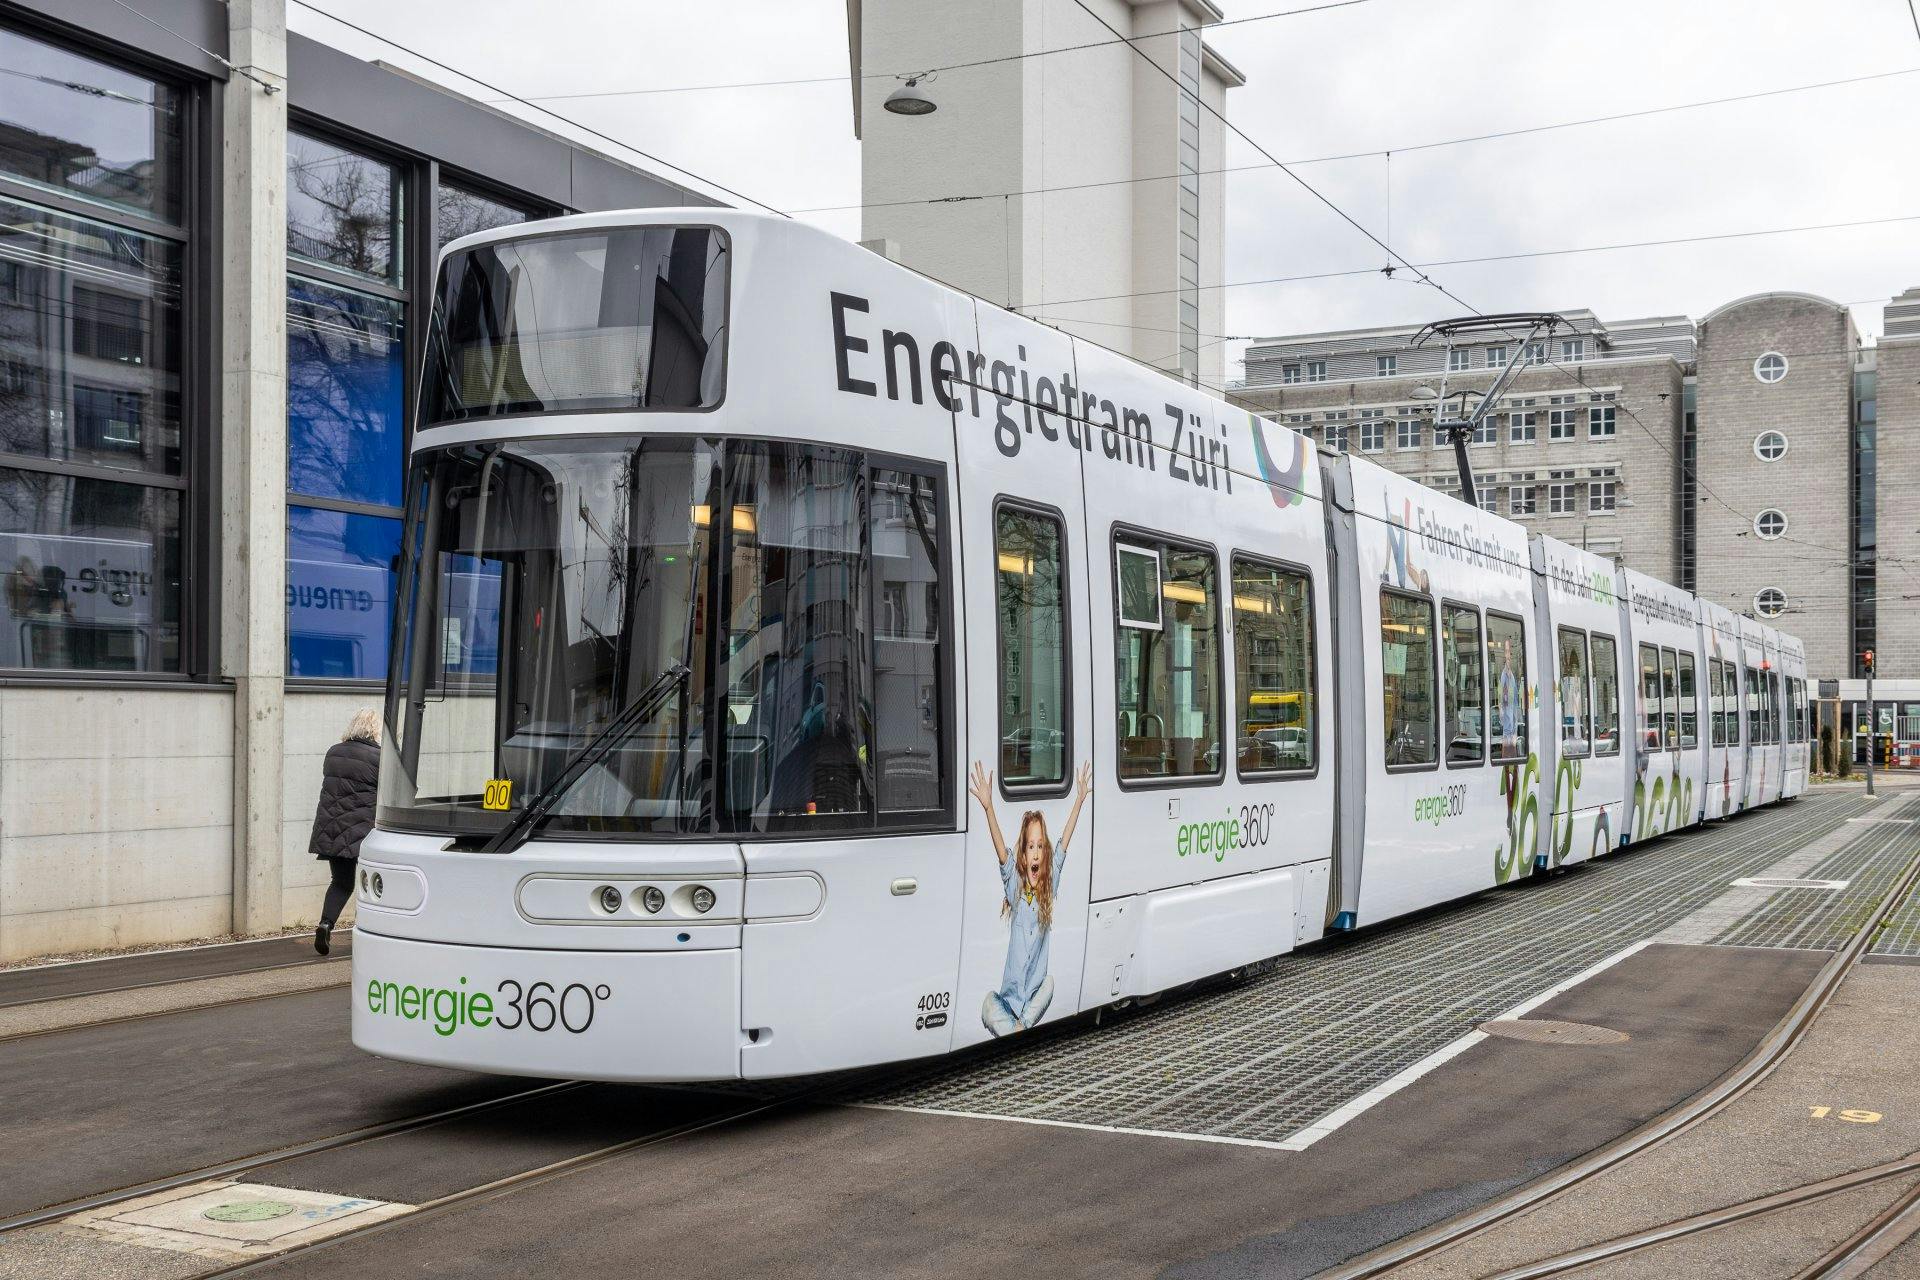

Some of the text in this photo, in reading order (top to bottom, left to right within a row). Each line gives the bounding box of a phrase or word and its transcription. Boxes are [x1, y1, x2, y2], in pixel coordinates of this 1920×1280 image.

[830, 291, 1232, 496] Energietram Züri
[1417, 506, 1522, 581] Fahren Sie mit uns
[1177, 803, 1275, 862] energie360°
[1414, 784, 1467, 826] energie360°
[368, 976, 611, 1036] energie360°
[917, 991, 950, 1011] 4003
[1808, 1106, 1883, 1123] 19
